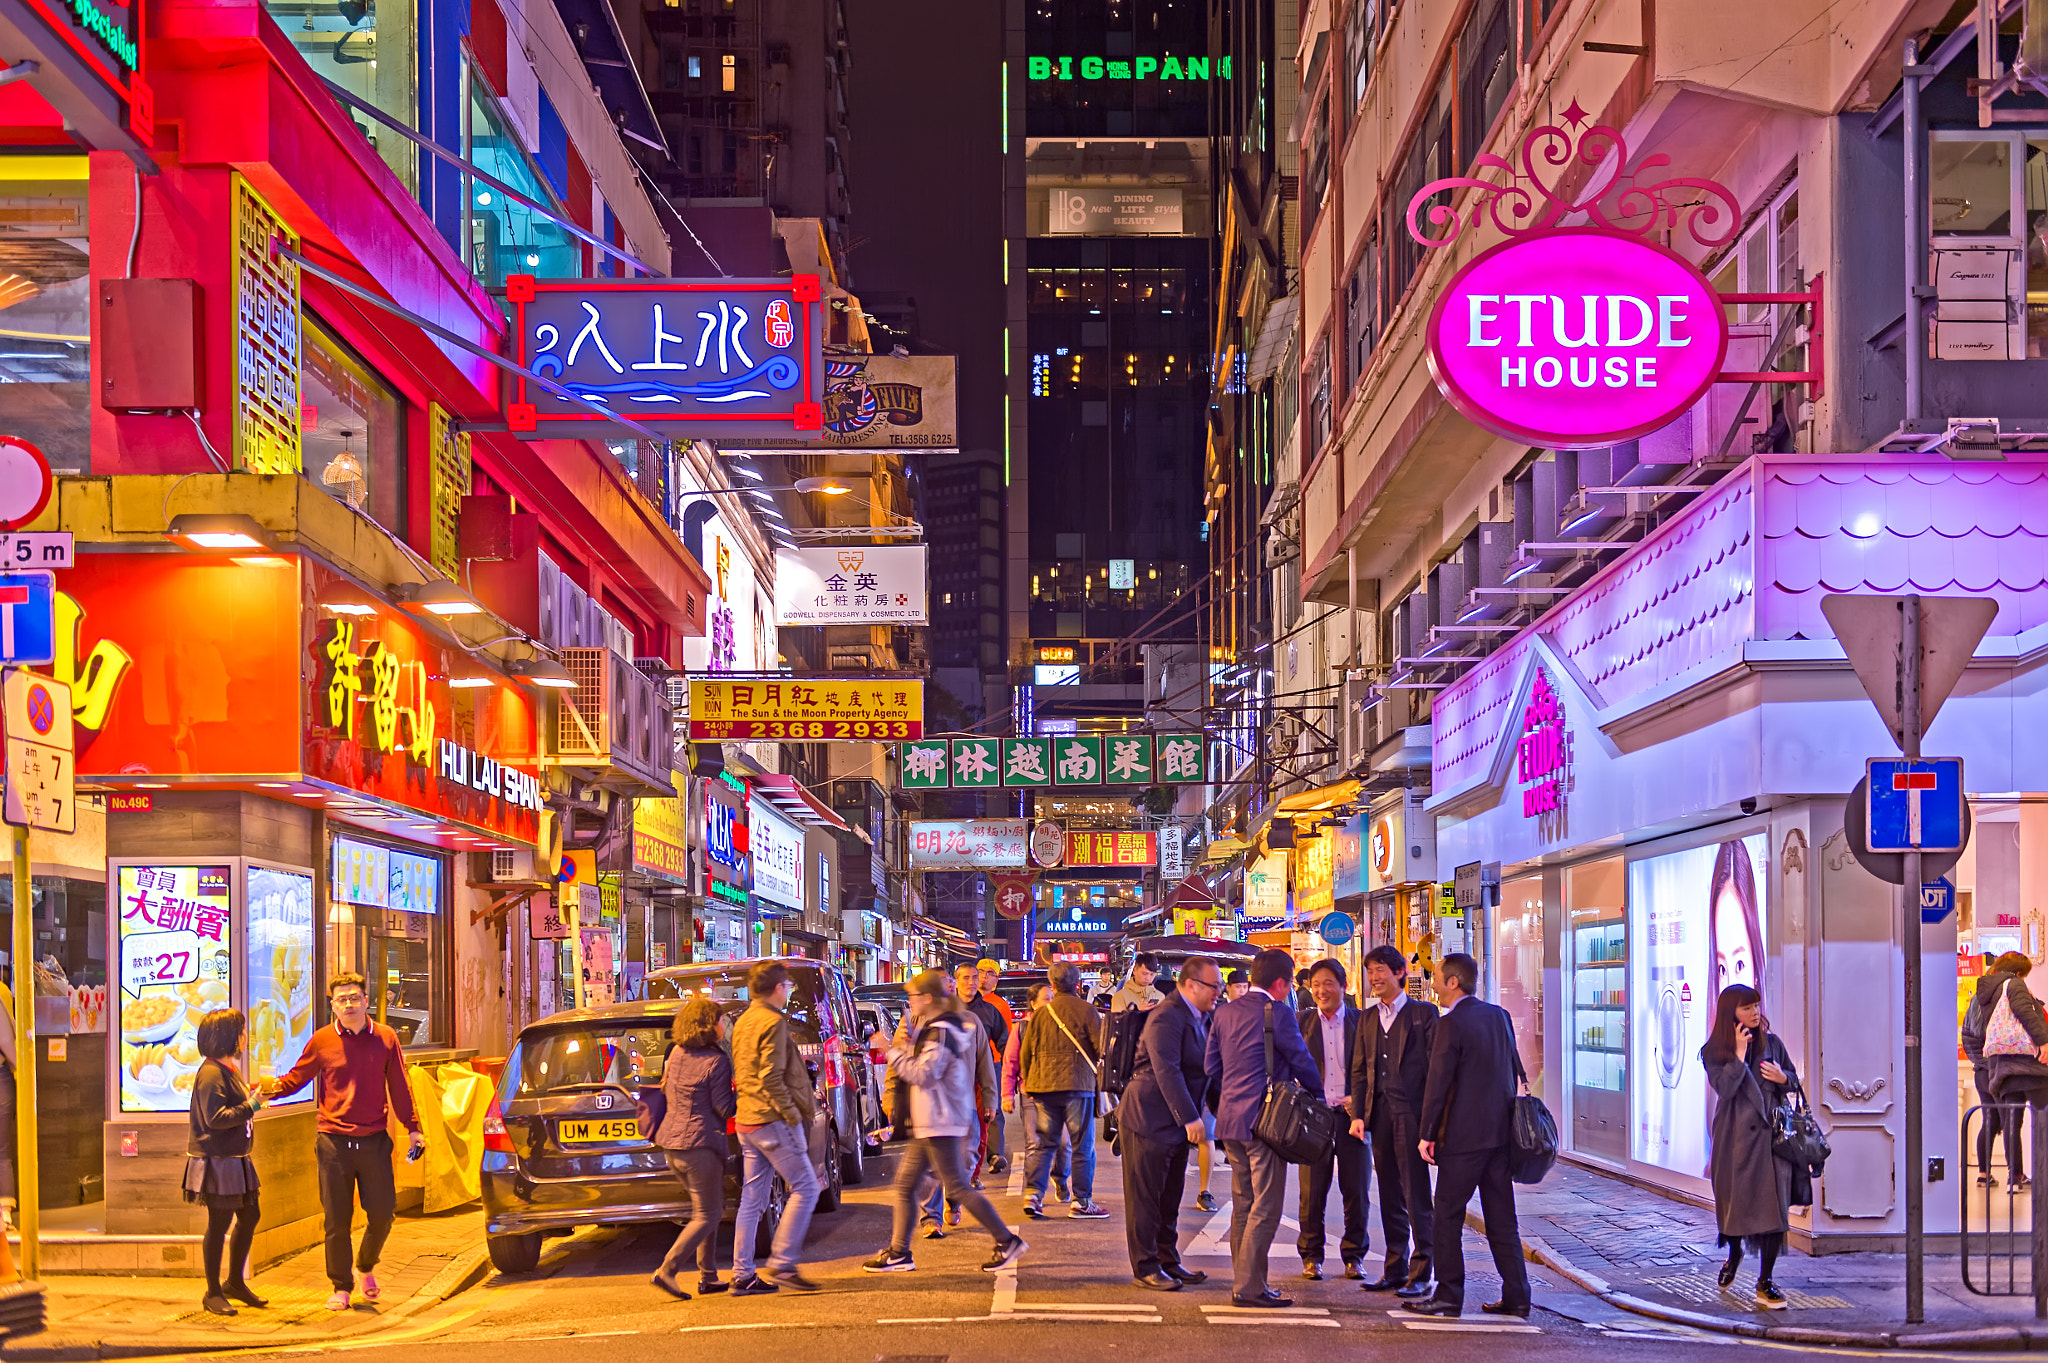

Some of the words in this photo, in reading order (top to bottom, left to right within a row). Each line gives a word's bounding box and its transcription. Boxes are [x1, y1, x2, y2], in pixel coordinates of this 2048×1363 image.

[1029, 57, 1104, 80] BIG
[1135, 57, 1209, 80] PAN
[1107, 61, 1129, 71] HONG
[1109, 70, 1131, 79] KONG
[1113, 195, 1154, 203] DINING
[1121, 206, 1146, 214] LIFE
[1113, 217, 1156, 225] BEAUTY
[1465, 294, 1692, 348] ETUDE
[1501, 356, 1658, 388] HOUSE
[877, 386, 915, 411] FIVE
[931, 434, 952, 444] 6225
[16, 540, 32, 562] 5
[43, 545, 65, 561] m
[824, 573, 878, 592] 金英
[818, 611, 859, 619] DISPENSARY
[870, 610, 905, 618] COSMETIC
[704, 685, 722, 697] SUN
[732, 684, 818, 708] 日月紅
[731, 709, 749, 718] The
[752, 709, 770, 718] Sun
[773, 709, 780, 718] &
[783, 709, 799, 718] the
[801, 709, 827, 718] Moon
[830, 709, 871, 720] Property
[873, 709, 909, 720] Agency
[750, 722, 824, 738] 2368
[834, 722, 909, 738] 2933
[25, 747, 37, 757] am
[1517, 718, 1563, 785] ETUDE
[22, 760, 41, 777] 上午
[52, 755, 61, 780] 7
[441, 738, 467, 786] HUI
[472, 751, 500, 797] LAU
[504, 766, 540, 812] SHAN
[112, 797, 149, 809] No.49C
[1523, 778, 1560, 818] HOUSE
[24, 804, 42, 821] 下午
[52, 798, 62, 823] 7
[916, 830, 972, 855] 明苑
[973, 843, 1025, 858] 茶餐廳
[1073, 834, 1113, 863] 潮福
[644, 837, 664, 867] 2368
[665, 846, 684, 874] 2933
[137, 867, 176, 893] 會員
[1002, 888, 1025, 912] 押
[123, 889, 230, 942] 大酬賓
[1046, 922, 1107, 931] HANBANDO
[564, 1123, 589, 1139] UM
[598, 1122, 636, 1138] 459
